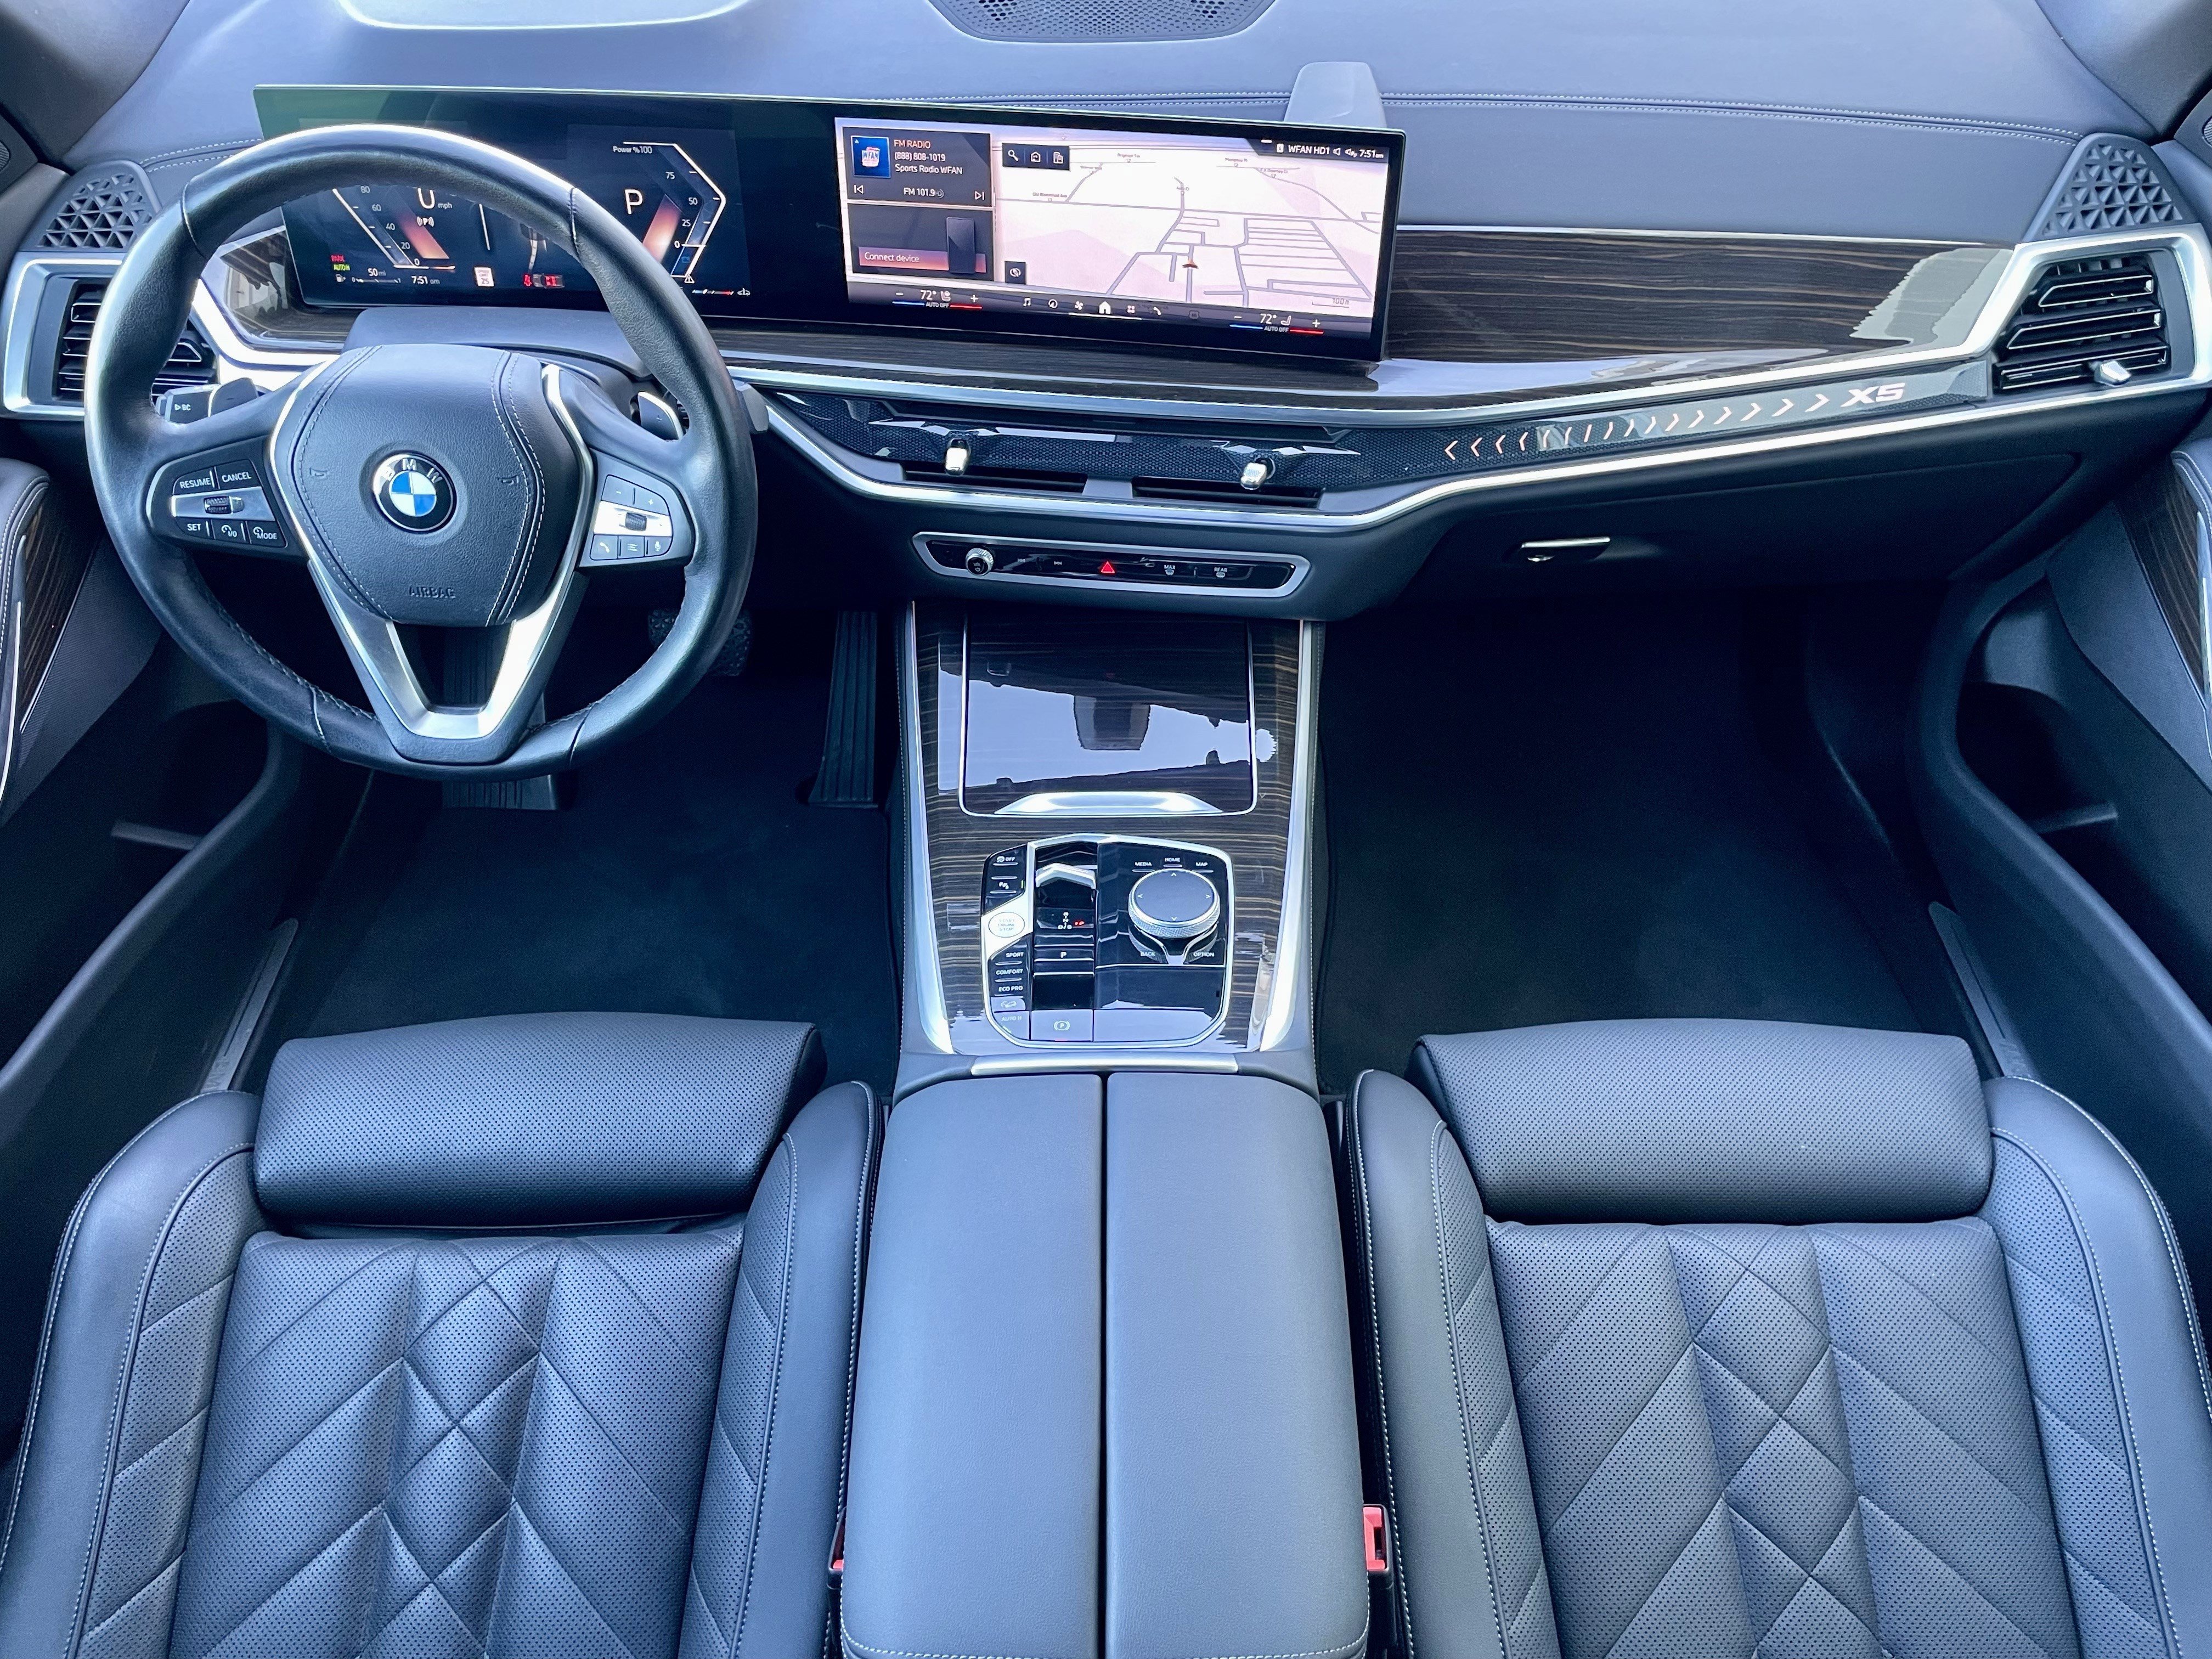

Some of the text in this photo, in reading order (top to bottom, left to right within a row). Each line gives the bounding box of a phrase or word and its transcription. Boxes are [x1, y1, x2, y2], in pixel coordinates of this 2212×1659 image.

[907, 140, 931, 149] RADIO
[1288, 145, 1312, 154] WFAN
[1313, 146, 1330, 155] HD1
[894, 151, 946, 162] (888) 808-1019
[895, 163, 963, 174] Sports Radio WFAN
[665, 172, 675, 180] 75
[360, 185, 370, 194] 80
[903, 187, 935, 197] FM 101.9
[624, 189, 643, 215] P
[689, 197, 698, 206] 50
[372, 204, 381, 212] 60
[386, 223, 396, 231] 40
[682, 219, 691, 227] 25
[400, 241, 411, 250] 20
[674, 240, 680, 249] 0
[414, 258, 420, 266] 0
[865, 252, 919, 263] Connect device
[368, 268, 379, 276] 50
[411, 275, 428, 284] 7:51
[1841, 382, 1906, 407] X5
[383, 459, 443, 483] BMW
[222, 472, 252, 483] CANCEL
[179, 477, 211, 489] RESUME
